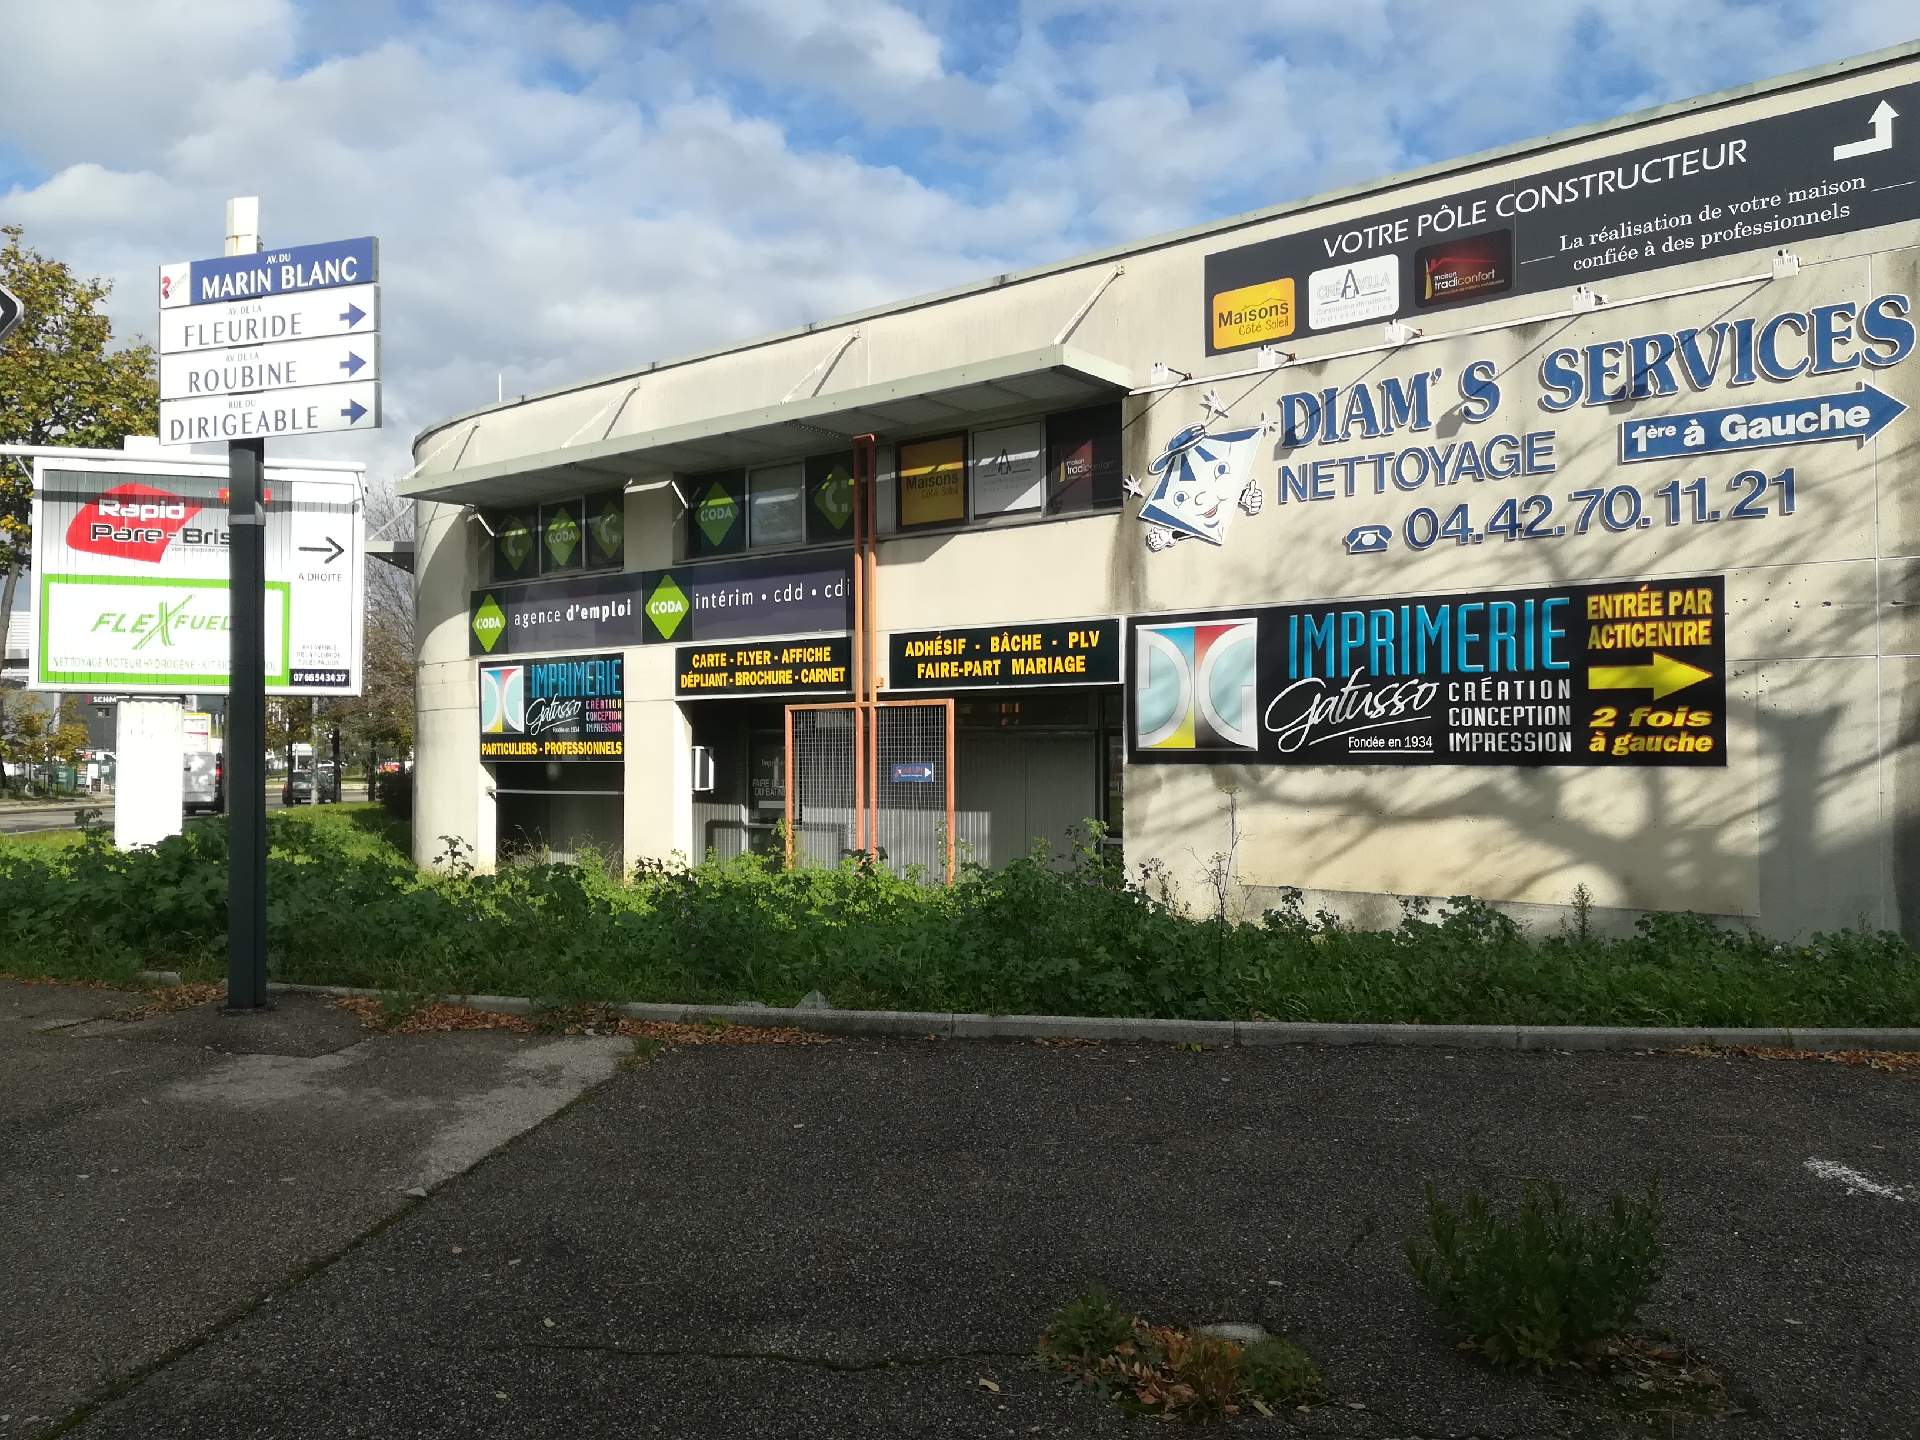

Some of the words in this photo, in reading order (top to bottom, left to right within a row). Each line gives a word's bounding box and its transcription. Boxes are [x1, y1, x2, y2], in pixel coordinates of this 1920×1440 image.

[1323, 219, 1409, 258] VOTRE
[1418, 200, 1487, 238] PÔLE
[1496, 139, 1747, 217] CONSTRUCTEUR
[1560, 234, 1583, 251] La
[1589, 211, 1693, 245] réalisation
[1698, 202, 1722, 221] de
[1728, 194, 1782, 216] votre
[1788, 174, 1866, 204] maison
[1573, 245, 1639, 271] confiée
[1644, 239, 1656, 256] à
[1661, 233, 1695, 253] des
[1700, 203, 1851, 249] professionnels
[279, 253, 291, 262] DU
[202, 268, 271, 299] MARIN
[281, 256, 358, 289] BLANC
[1434, 269, 1495, 290] tradiconfort
[1218, 302, 1289, 328] Maisons
[1239, 321, 1262, 336] Côté
[1266, 316, 1288, 330] Soleil
[184, 312, 302, 347] FLEURIDE
[1539, 294, 1918, 413] SERVICES
[188, 361, 297, 393] ROUBINE
[229, 400, 243, 408] RUE
[170, 406, 319, 440] DIRIGEABLE
[1684, 419, 1704, 447] à
[1720, 403, 1870, 442] Gauche
[1279, 430, 1556, 504] NETTOYAGE
[99, 498, 185, 520] Rapid
[700, 505, 733, 523] CODA
[1405, 467, 1797, 550] 04.42.70.11.21
[91, 523, 163, 543] Pare
[182, 527, 230, 545] Bris
[307, 573, 343, 582] DROITE
[696, 589, 753, 610] intérim
[774, 583, 803, 603] cdd
[824, 578, 850, 598] cdi
[1587, 584, 1664, 620] ENTRÉE
[1668, 588, 1713, 616] PAR
[514, 608, 561, 627] agence
[566, 599, 632, 622] d'emploi
[651, 600, 683, 615] CODA
[476, 615, 501, 630] CODA
[1587, 620, 1713, 650] ACTICENTRE
[905, 636, 966, 657] ADHÉSIF
[990, 632, 1042, 653] BÂCHE
[1068, 630, 1100, 649] PLV
[1288, 596, 1571, 680] IMPRIMERIE
[692, 653, 727, 668] CARTE
[736, 650, 772, 666] FLYER
[781, 646, 832, 664] AFFICHE
[917, 659, 1001, 679] FAIRE-PART
[1011, 655, 1086, 676] MARIAGE
[531, 659, 622, 698] IMPRIMERIE
[681, 671, 728, 688] DÉPLIANT
[735, 669, 793, 686] BROCHURE
[800, 667, 846, 683] CARNET
[1449, 676, 1571, 701] CRÉATION
[585, 698, 622, 710] CRÉATION
[585, 710, 622, 721] CONCEPTION
[1264, 665, 1440, 753] Gatusso
[1449, 705, 1571, 727] CONCEPTION
[1589, 706, 1618, 728] 2
[1629, 705, 1713, 728] fois
[585, 722, 622, 733] IMPRESSION
[481, 742, 538, 756] PARTICULIERS
[544, 741, 623, 755] PROFESSIONNELS
[1349, 736, 1386, 748] Fondée
[1388, 738, 1401, 748] en
[1404, 735, 1433, 748] 1934
[1449, 731, 1572, 753] IMPRESSION
[1588, 731, 1606, 752] à
[1611, 731, 1713, 757] gauche
